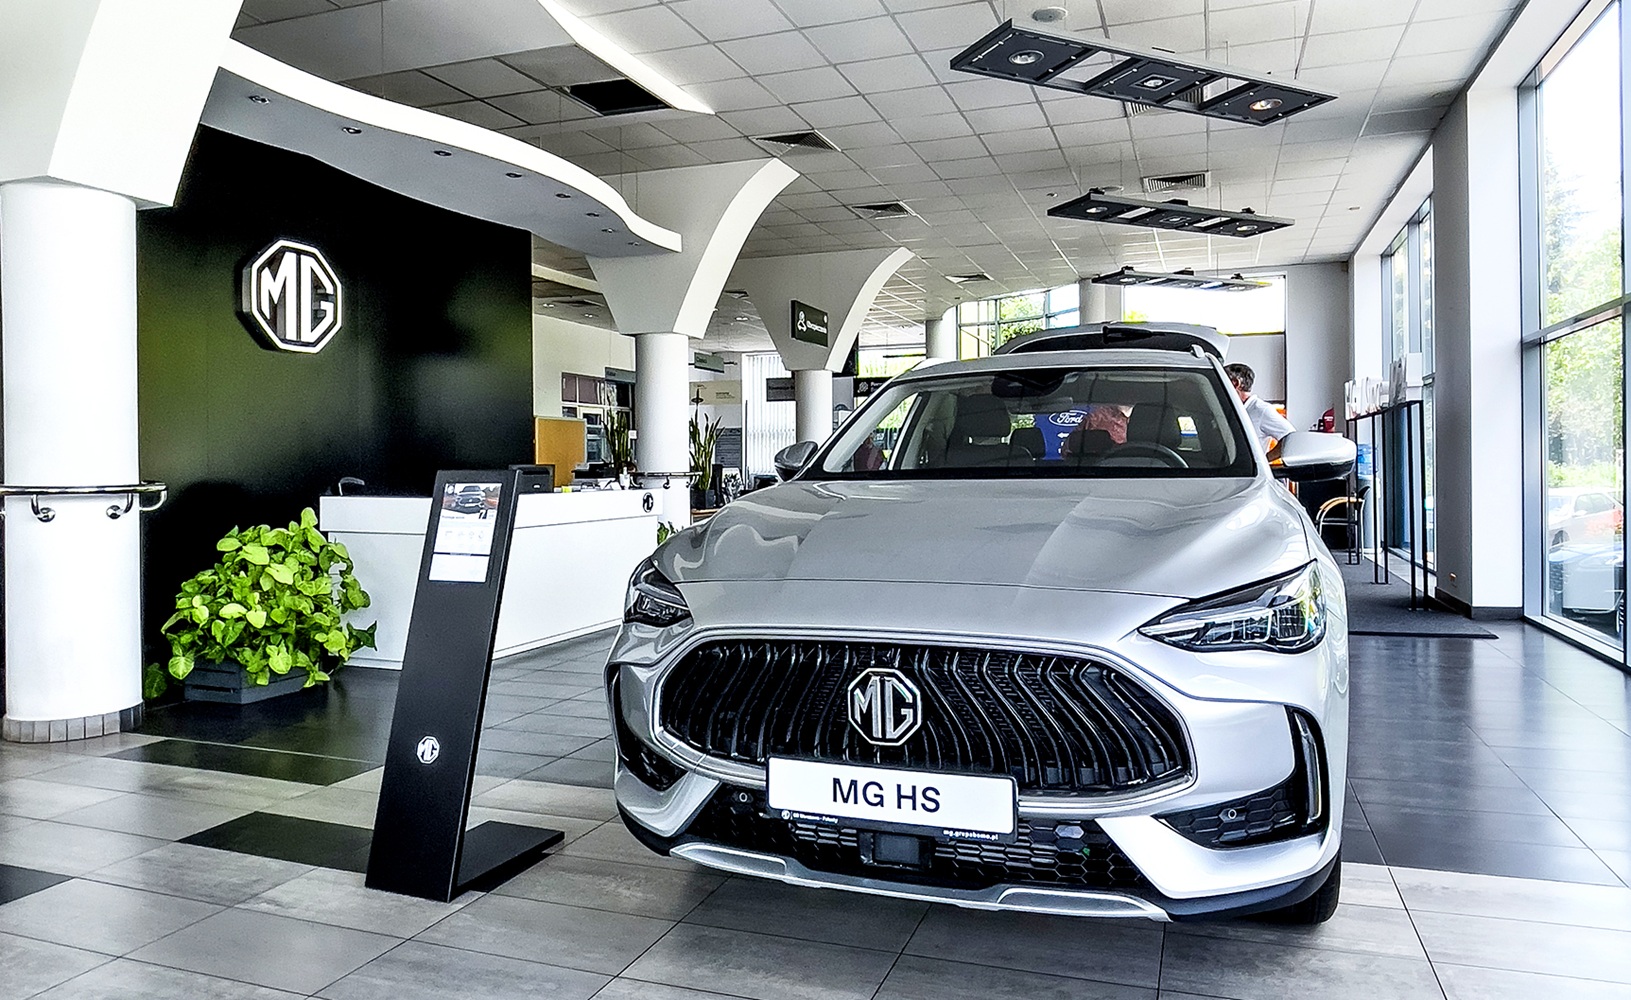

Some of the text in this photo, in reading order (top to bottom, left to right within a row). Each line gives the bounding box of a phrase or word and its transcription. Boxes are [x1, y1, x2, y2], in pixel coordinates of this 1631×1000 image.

[258, 249, 337, 345] MG
[1056, 411, 1084, 424] Ford
[852, 674, 914, 740] MG
[418, 738, 439, 762] MG
[832, 777, 941, 813] MG HS
